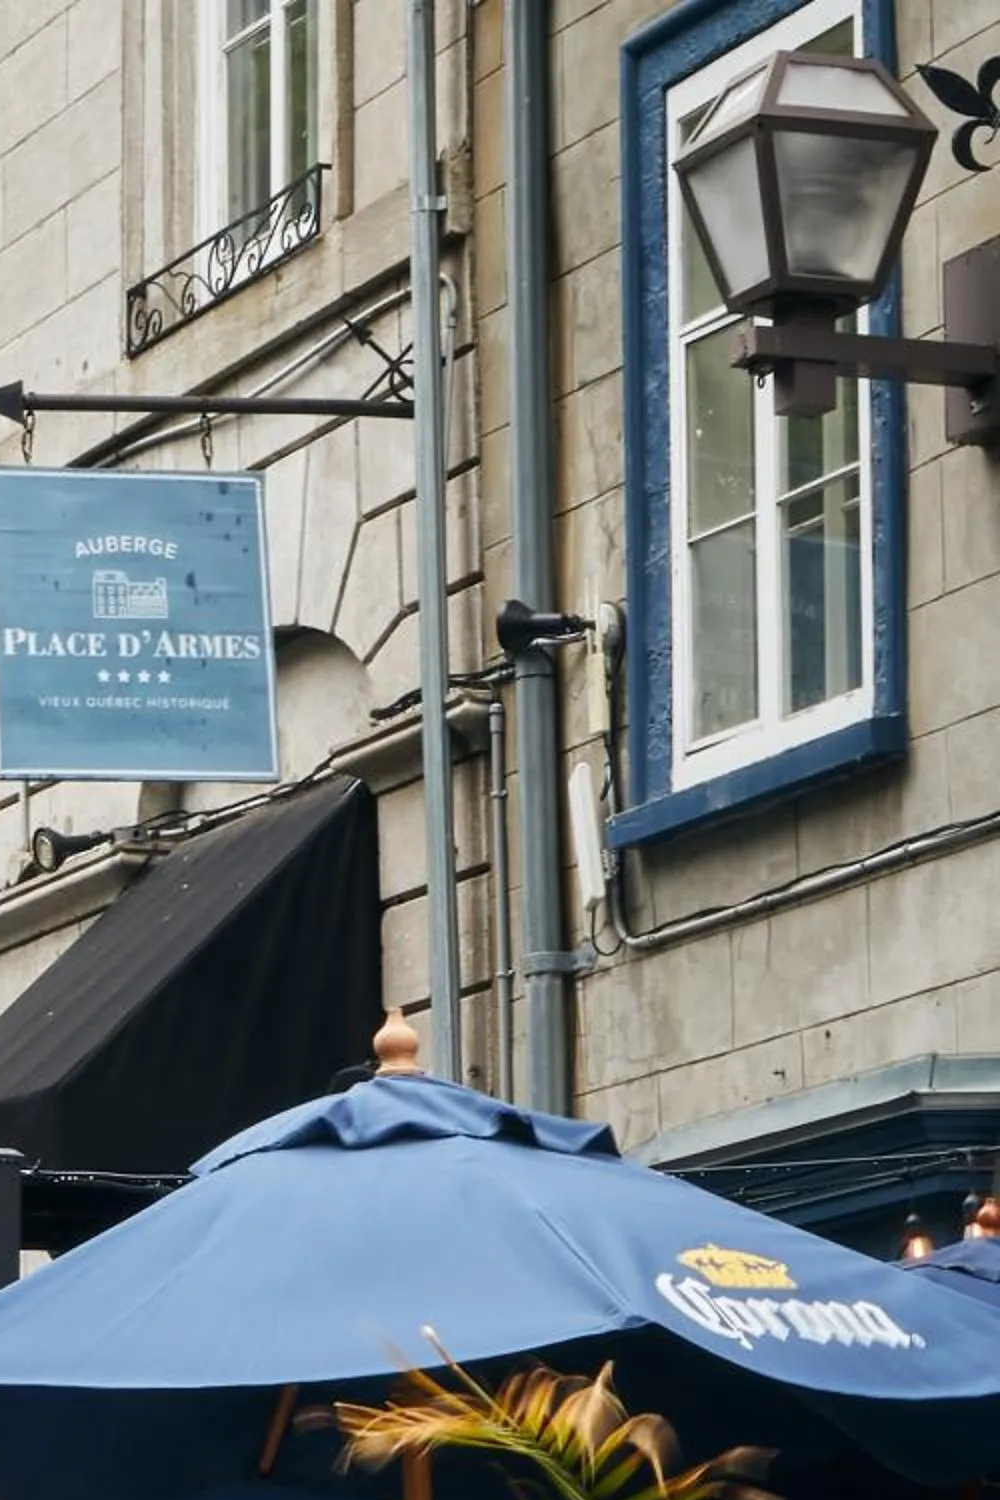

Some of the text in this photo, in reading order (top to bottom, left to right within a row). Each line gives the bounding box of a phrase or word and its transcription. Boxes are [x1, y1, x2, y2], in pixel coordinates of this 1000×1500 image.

[75, 535, 178, 560] AUBERGE
[3, 628, 261, 659] PLACE D'ARMES
[38, 694, 230, 710] VIEUX QUÉBEC HISTORIQUE
